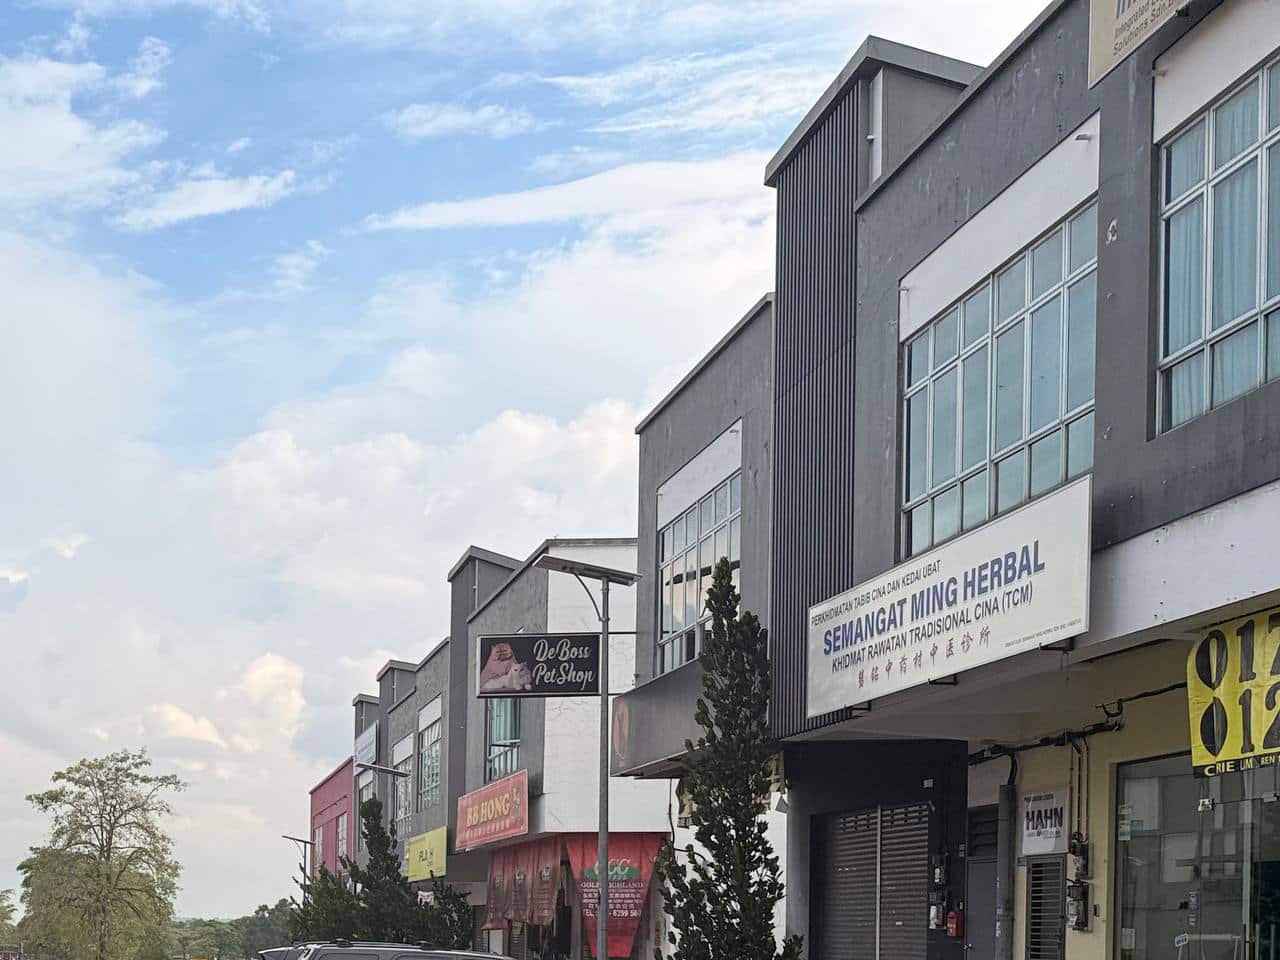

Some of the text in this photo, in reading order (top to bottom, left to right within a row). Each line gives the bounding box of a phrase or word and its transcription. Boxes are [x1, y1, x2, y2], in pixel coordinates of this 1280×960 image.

[811, 601, 853, 627] PERKHIDMATAN
[871, 587, 887, 601] CINA
[887, 579, 901, 594] DAN
[901, 568, 922, 587] KEDAI
[922, 559, 941, 578] UBAT
[823, 540, 1045, 656] SEMANGAT MING HERBAL
[832, 646, 866, 673] KHIDMAT
[867, 631, 907, 660] RAWATAN
[909, 608, 972, 646] TRADISIONAL
[974, 595, 1000, 621] CINA
[1002, 580, 1033, 614] (TCM)
[466, 806, 479, 828] BB
[480, 793, 511, 824] HONG
[1026, 806, 1063, 830] HAHN
